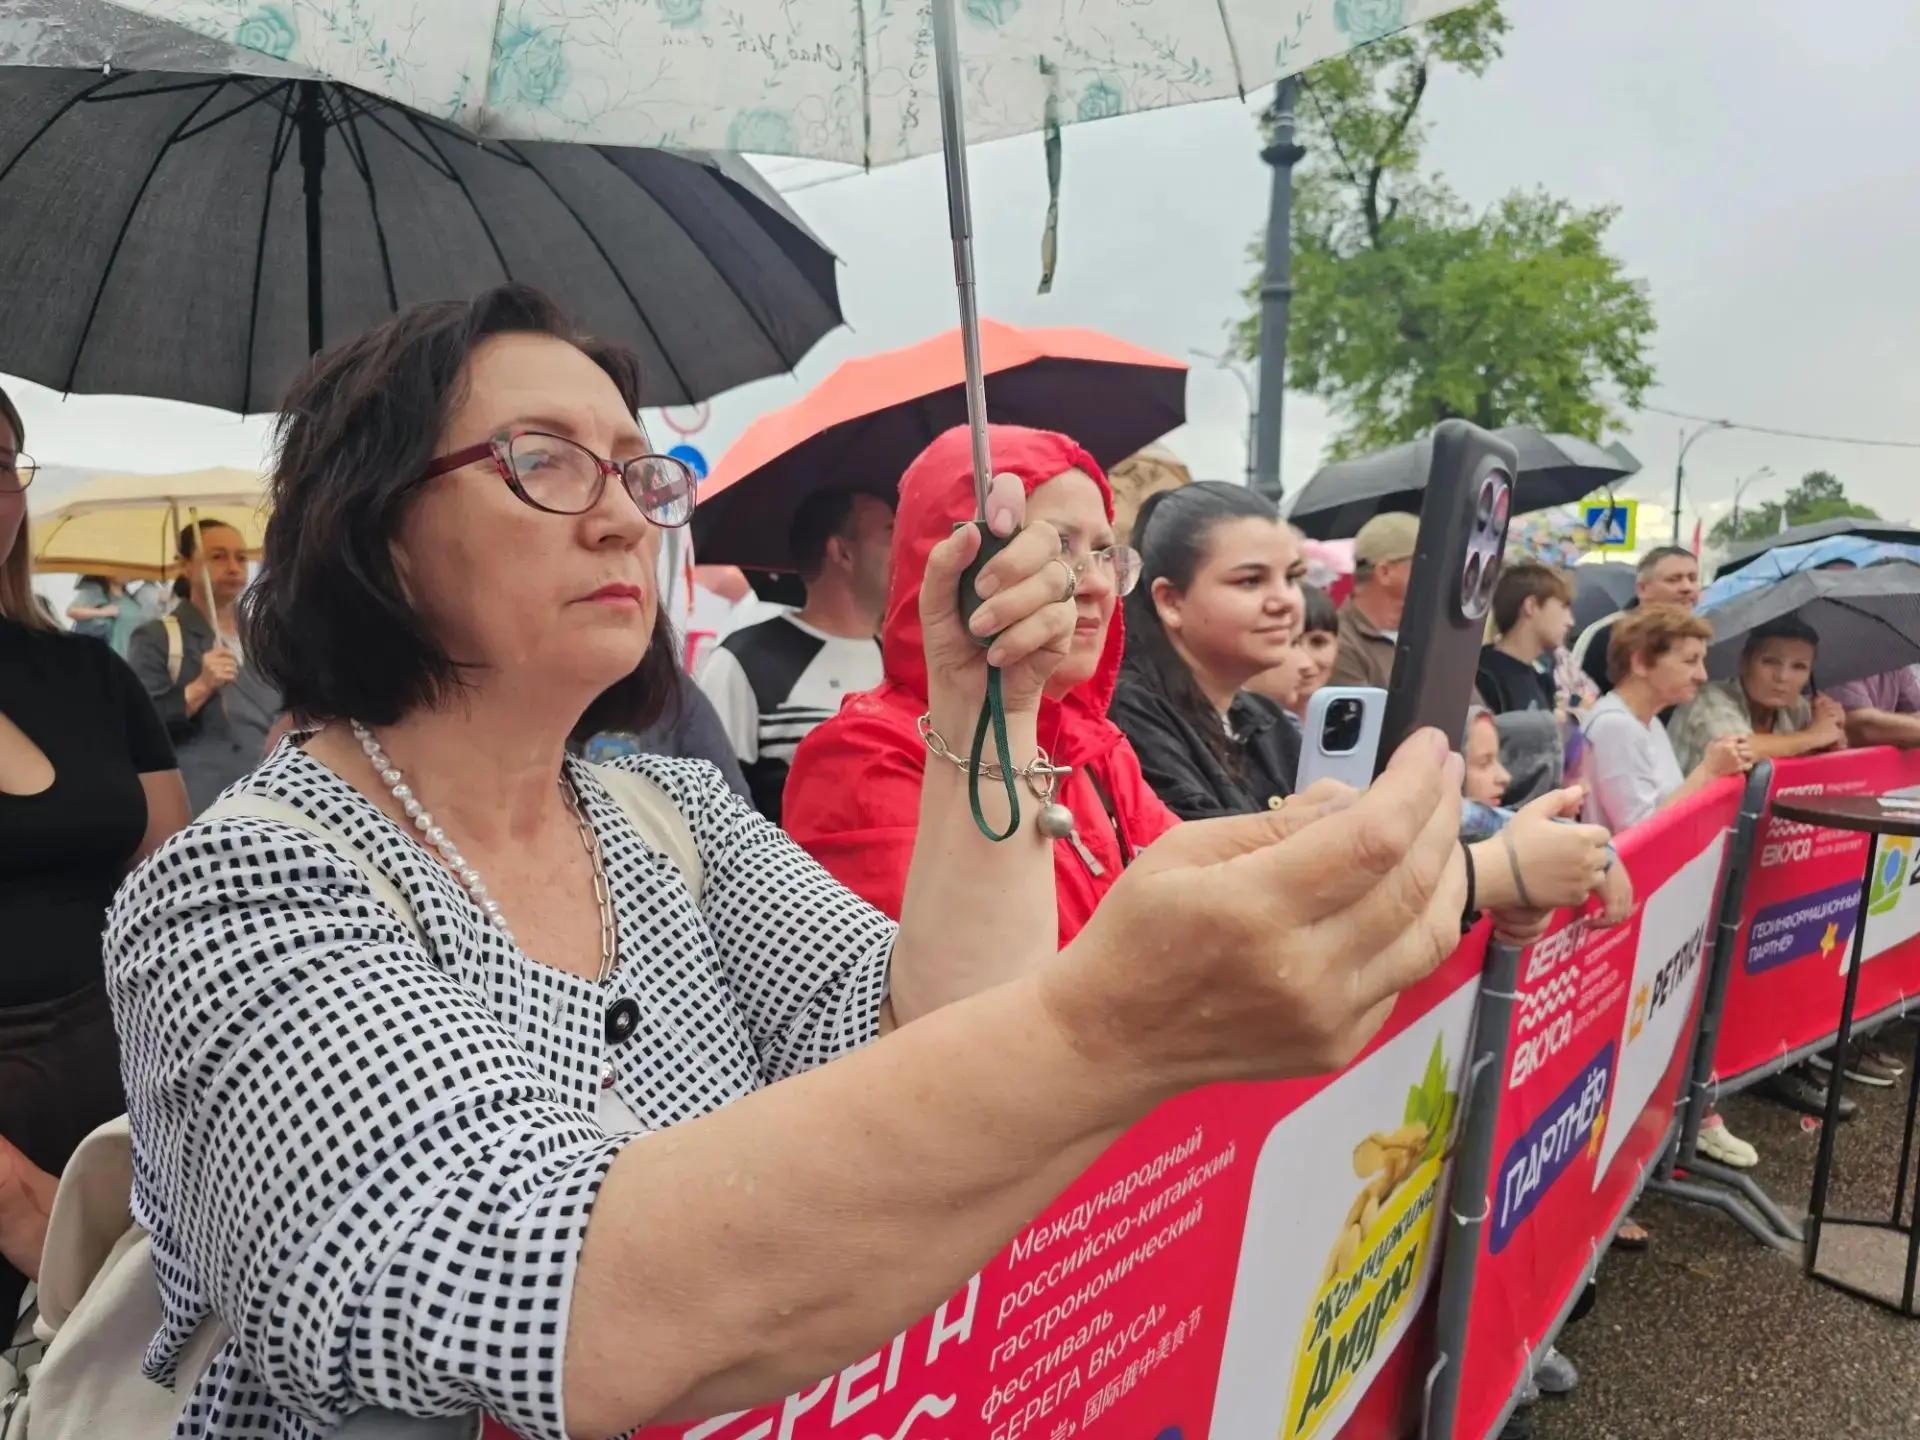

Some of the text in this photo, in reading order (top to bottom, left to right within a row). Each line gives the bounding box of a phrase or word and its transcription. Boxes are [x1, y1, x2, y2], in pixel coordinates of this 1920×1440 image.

[1509, 1010, 1574, 1091] ВКУСА
[1008, 1123, 1203, 1270] Международный
[1500, 1066, 1608, 1230] ПАРТНЁР
[989, 1196, 1203, 1373] гастрономический
[996, 1139, 1237, 1330] российско-китайский
[981, 1308, 1115, 1424] фестиваль
[1087, 1303, 1167, 1380] ВКУСА»
